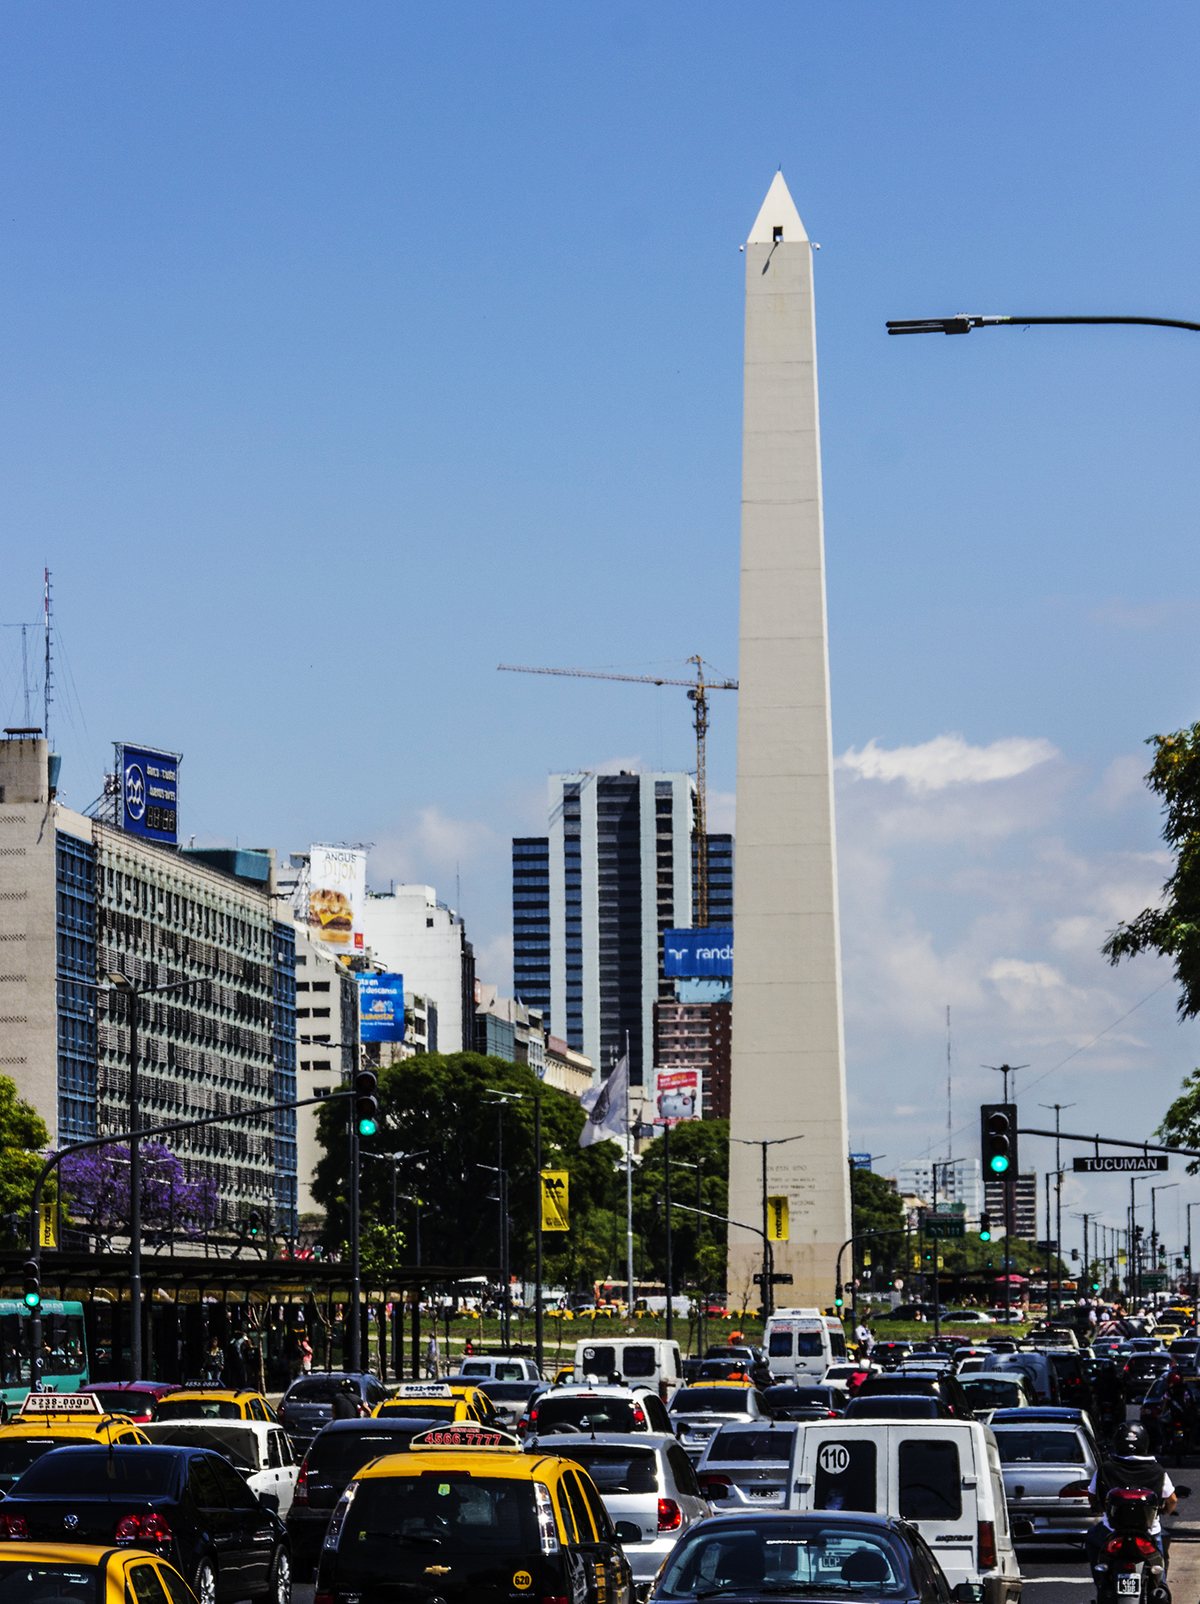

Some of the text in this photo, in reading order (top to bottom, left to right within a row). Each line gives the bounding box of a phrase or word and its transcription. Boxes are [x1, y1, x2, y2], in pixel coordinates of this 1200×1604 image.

[325, 852, 357, 863] ANGUS
[1085, 1158, 1158, 1171] TUCUMAN
[31, 1398, 90, 1406] 5238-0000
[424, 1432, 502, 1446] 4566-7777
[821, 1448, 848, 1469] 110
[514, 1575, 531, 1586] 620
